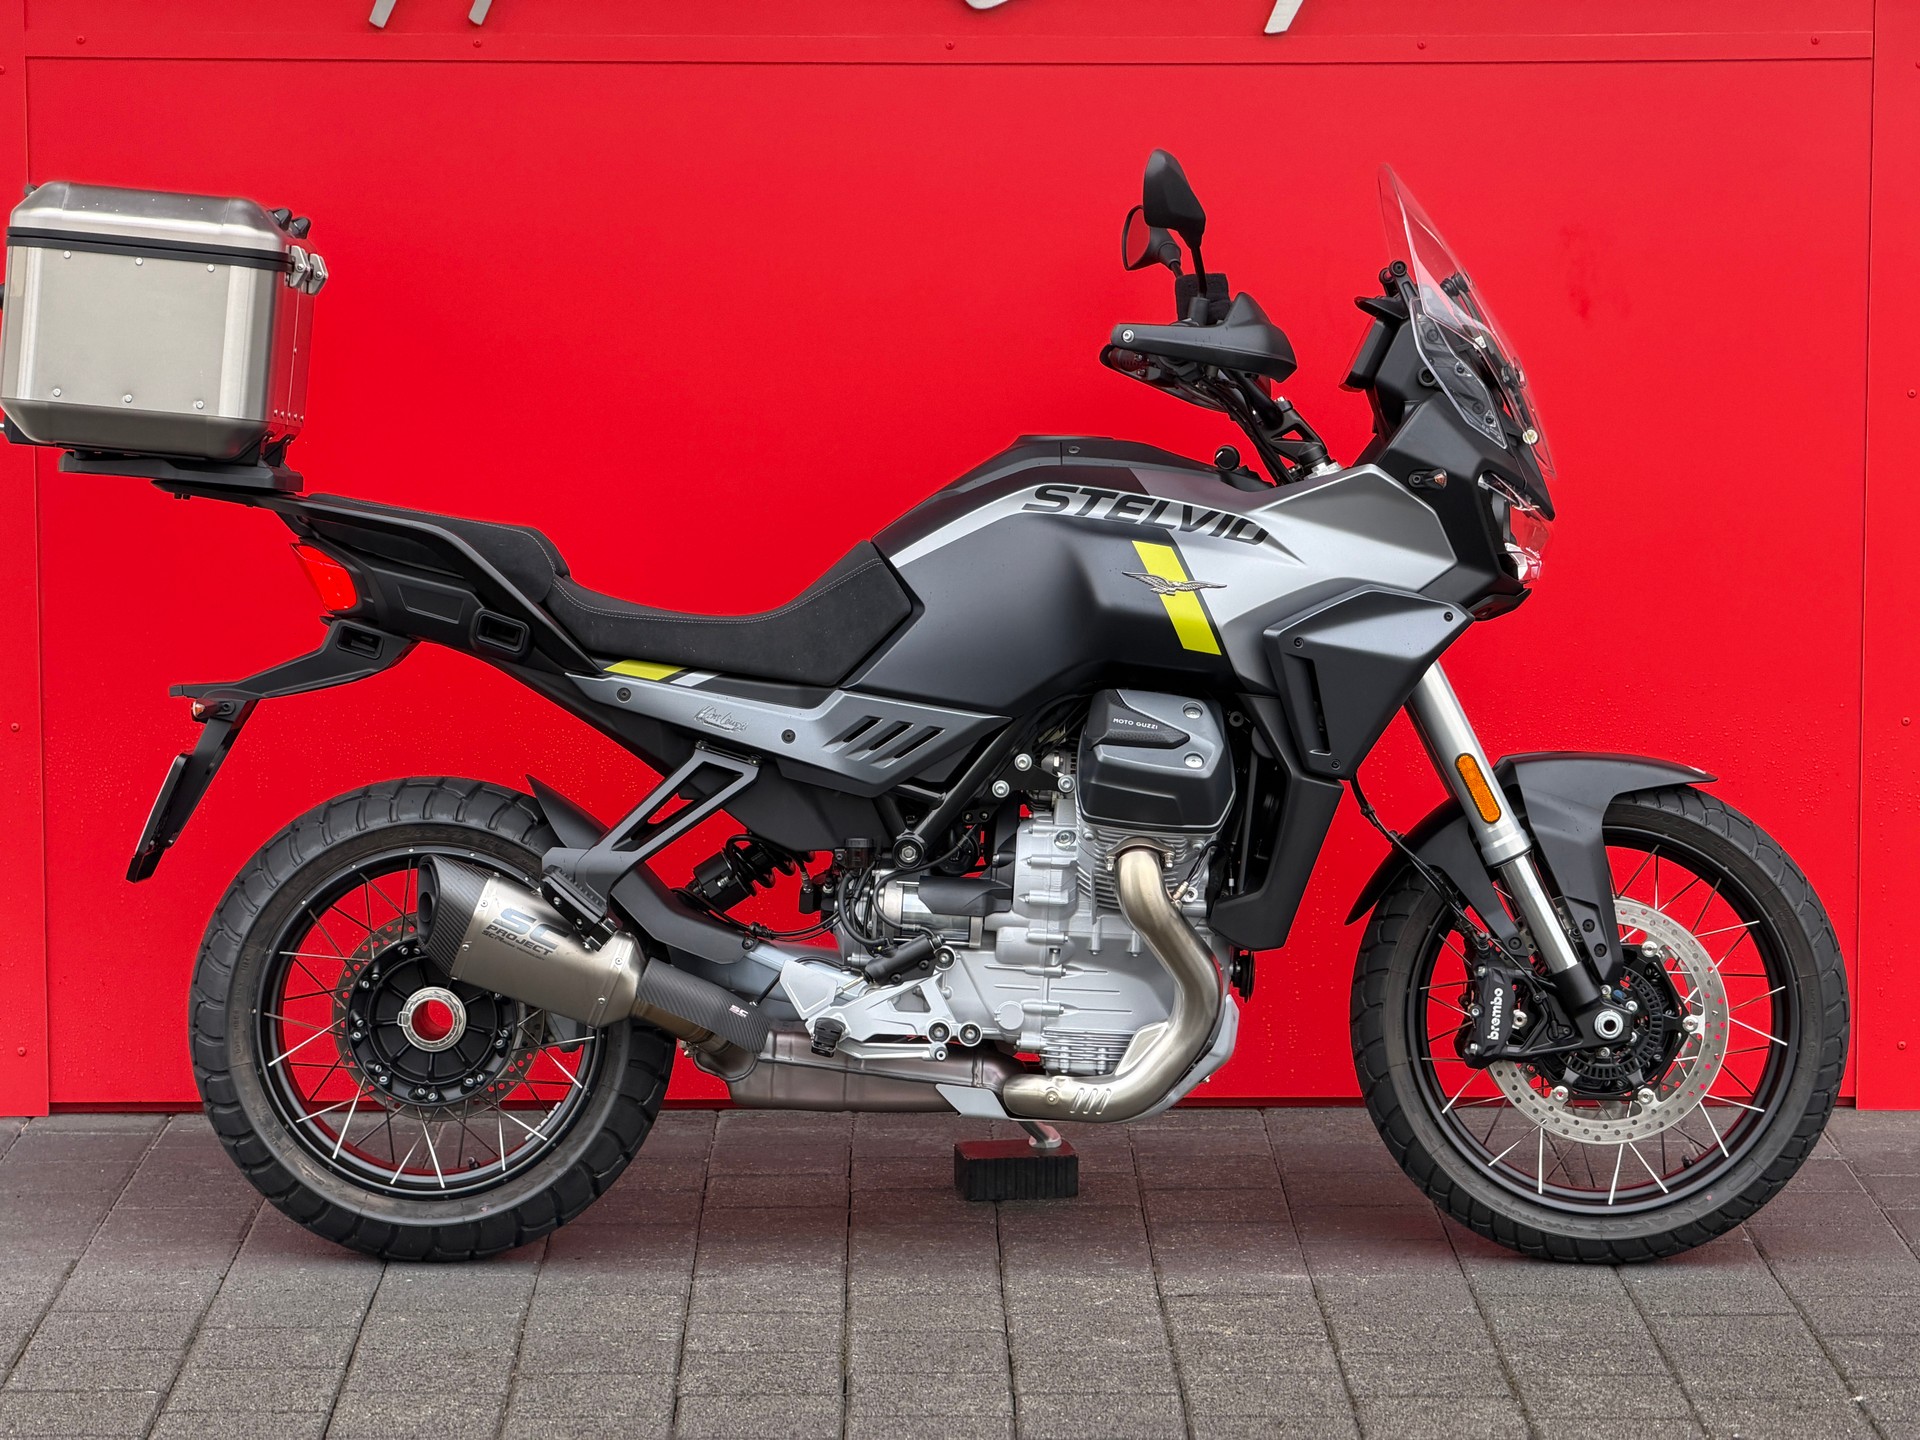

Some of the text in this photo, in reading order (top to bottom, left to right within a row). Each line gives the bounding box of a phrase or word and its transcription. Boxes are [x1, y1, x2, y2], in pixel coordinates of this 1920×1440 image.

[1021, 484, 1269, 545] STELVIO
[1113, 718, 1158, 730] MOTO GUZZI
[485, 924, 553, 956] PROJECT
[492, 908, 570, 950] SC
[1487, 988, 1503, 1040] brembo
